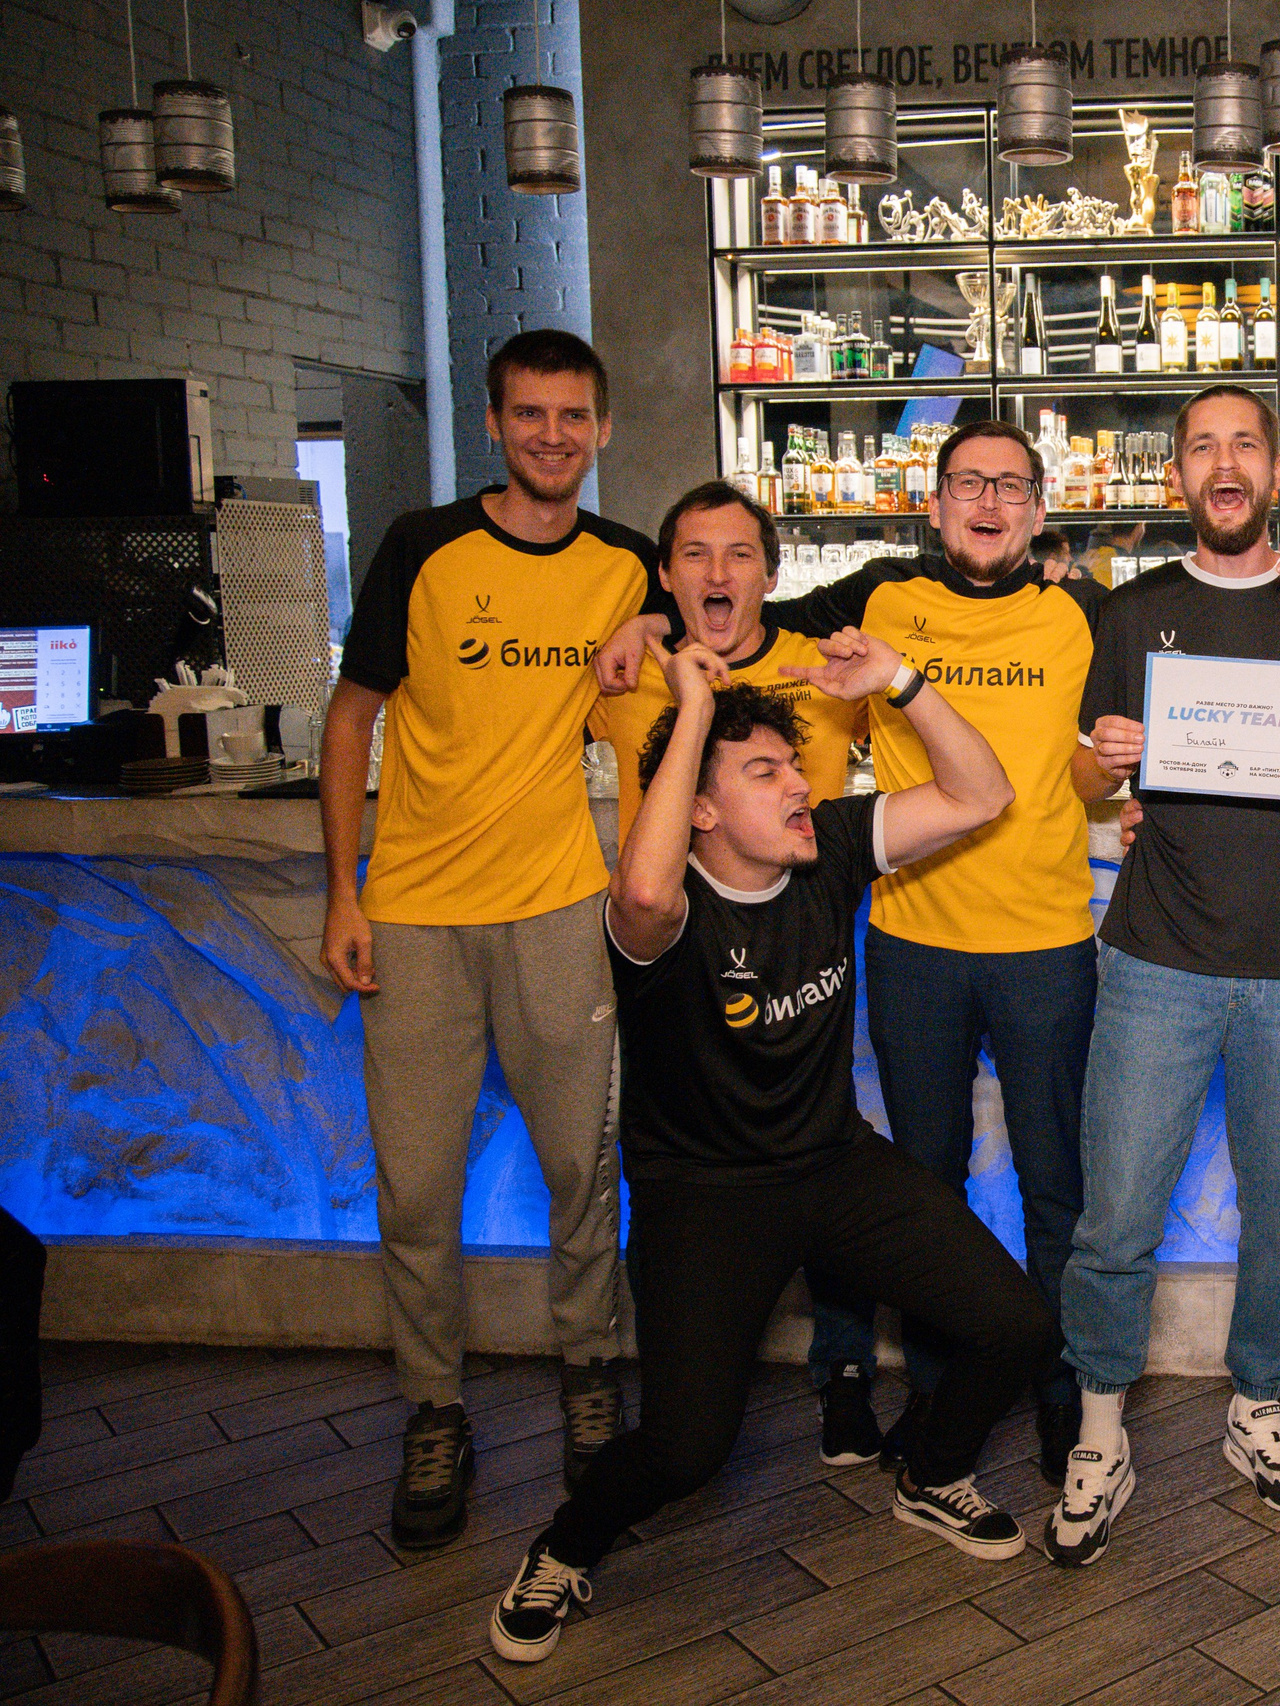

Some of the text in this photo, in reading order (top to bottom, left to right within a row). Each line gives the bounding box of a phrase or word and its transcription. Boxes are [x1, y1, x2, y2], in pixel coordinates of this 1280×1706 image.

[953, 39, 1091, 84] ВЕЧМ
[1102, 35, 1228, 79] ТЕМНОЕ
[466, 615, 502, 624] JÖGEL
[904, 632, 936, 645] JÖGEL
[500, 639, 600, 667] билай
[923, 657, 1045, 687] билайн
[1167, 706, 1235, 723] LUCKY
[1159, 760, 1207, 768] РОСТОВ-НА-ДОНУ
[720, 969, 758, 980] JÖGEL
